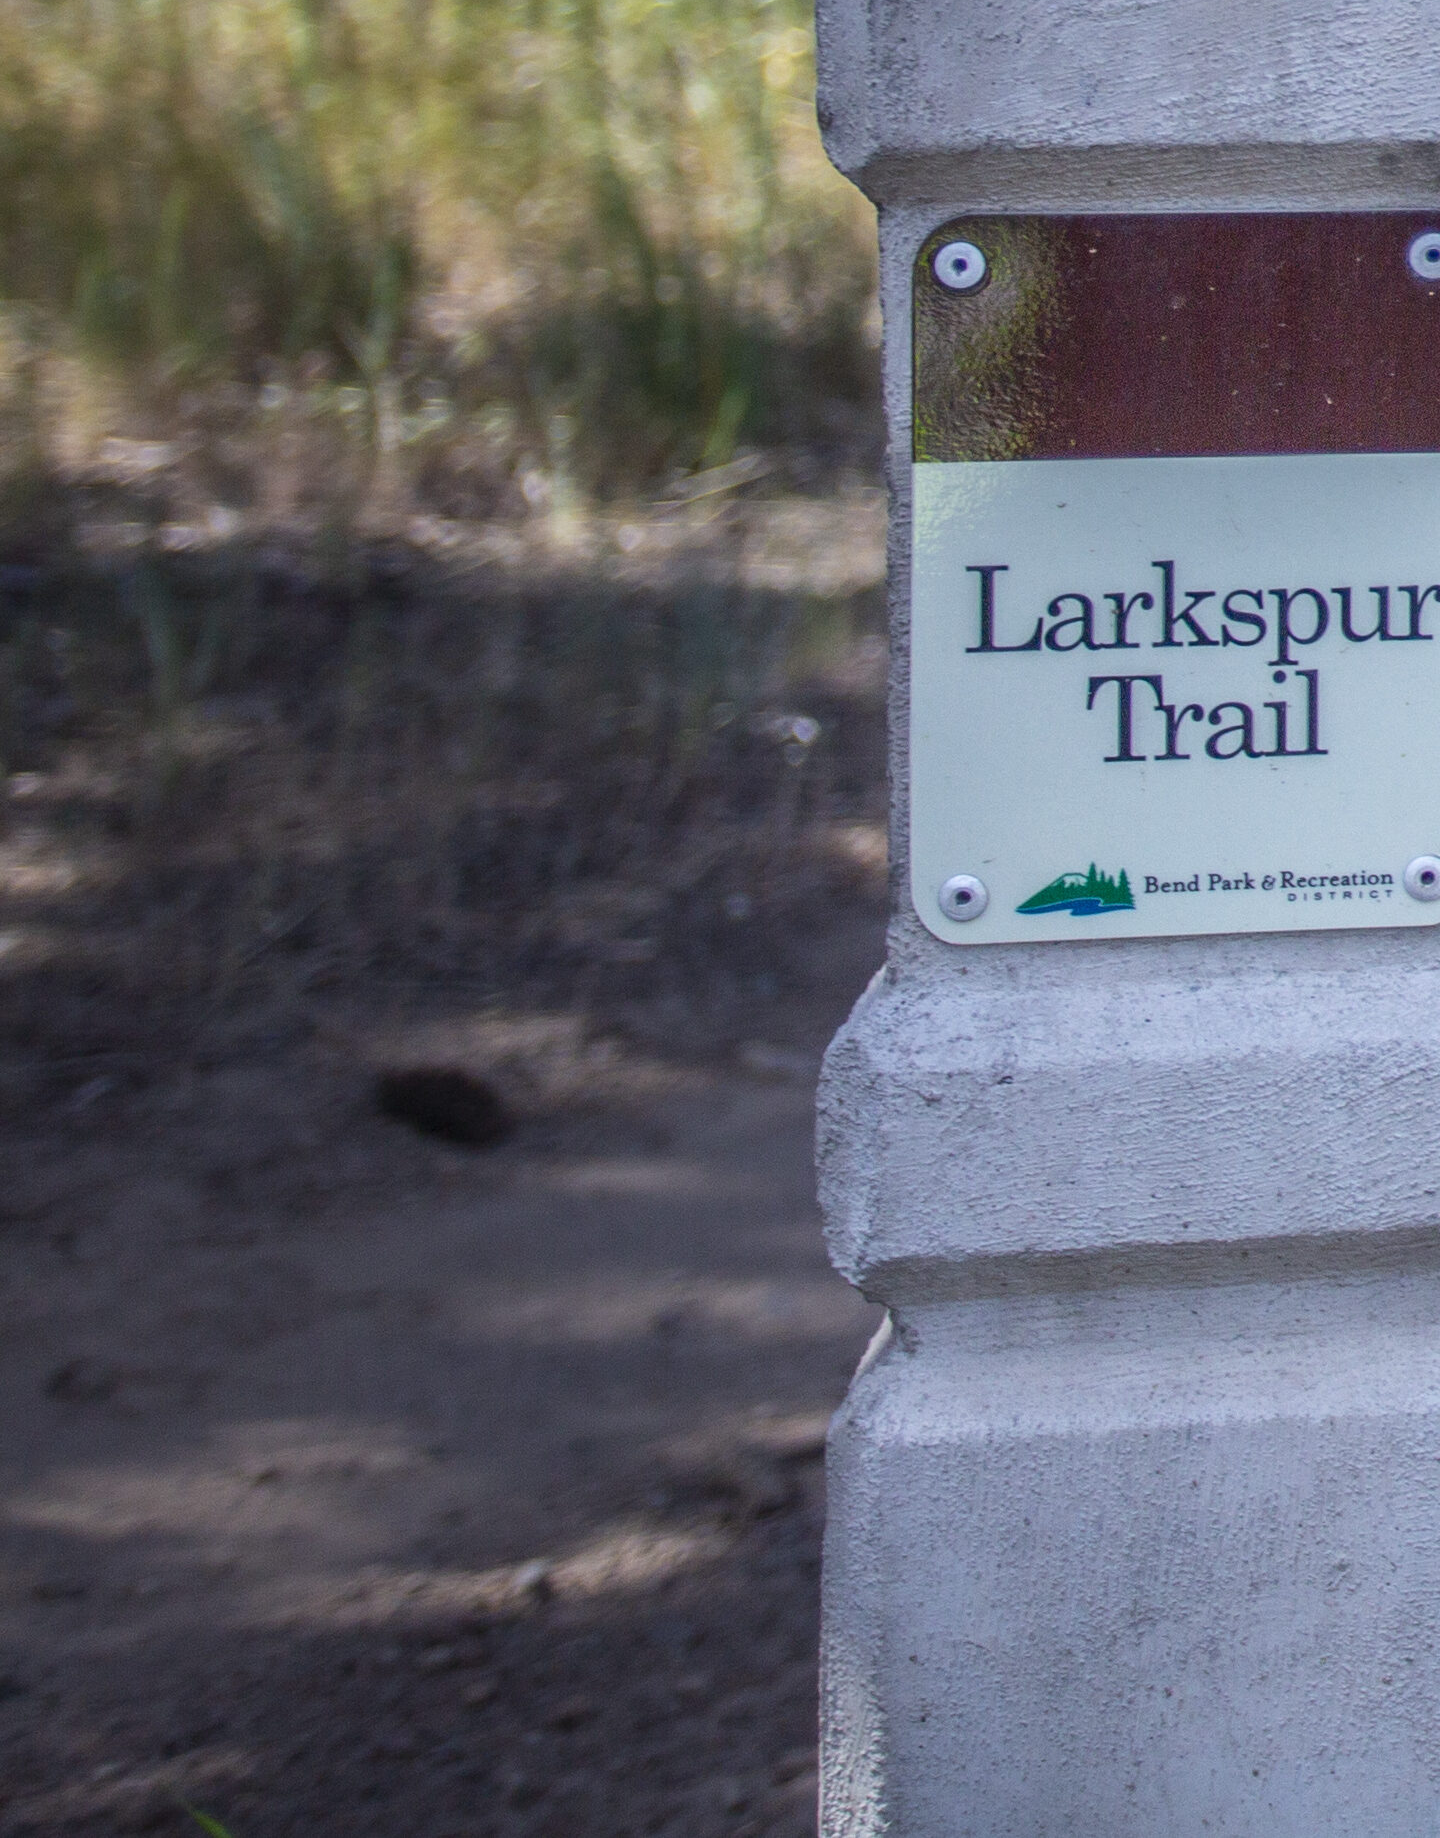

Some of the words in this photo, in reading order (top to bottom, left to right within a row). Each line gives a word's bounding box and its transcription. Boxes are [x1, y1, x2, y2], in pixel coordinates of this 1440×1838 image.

[1087, 670, 1328, 762] Trail
[1144, 874, 1200, 894] Bend
[1208, 872, 1255, 891] Park
[1261, 874, 1276, 891] &
[1280, 870, 1395, 890] Recreation
[1287, 890, 1393, 902] DISTRICT
